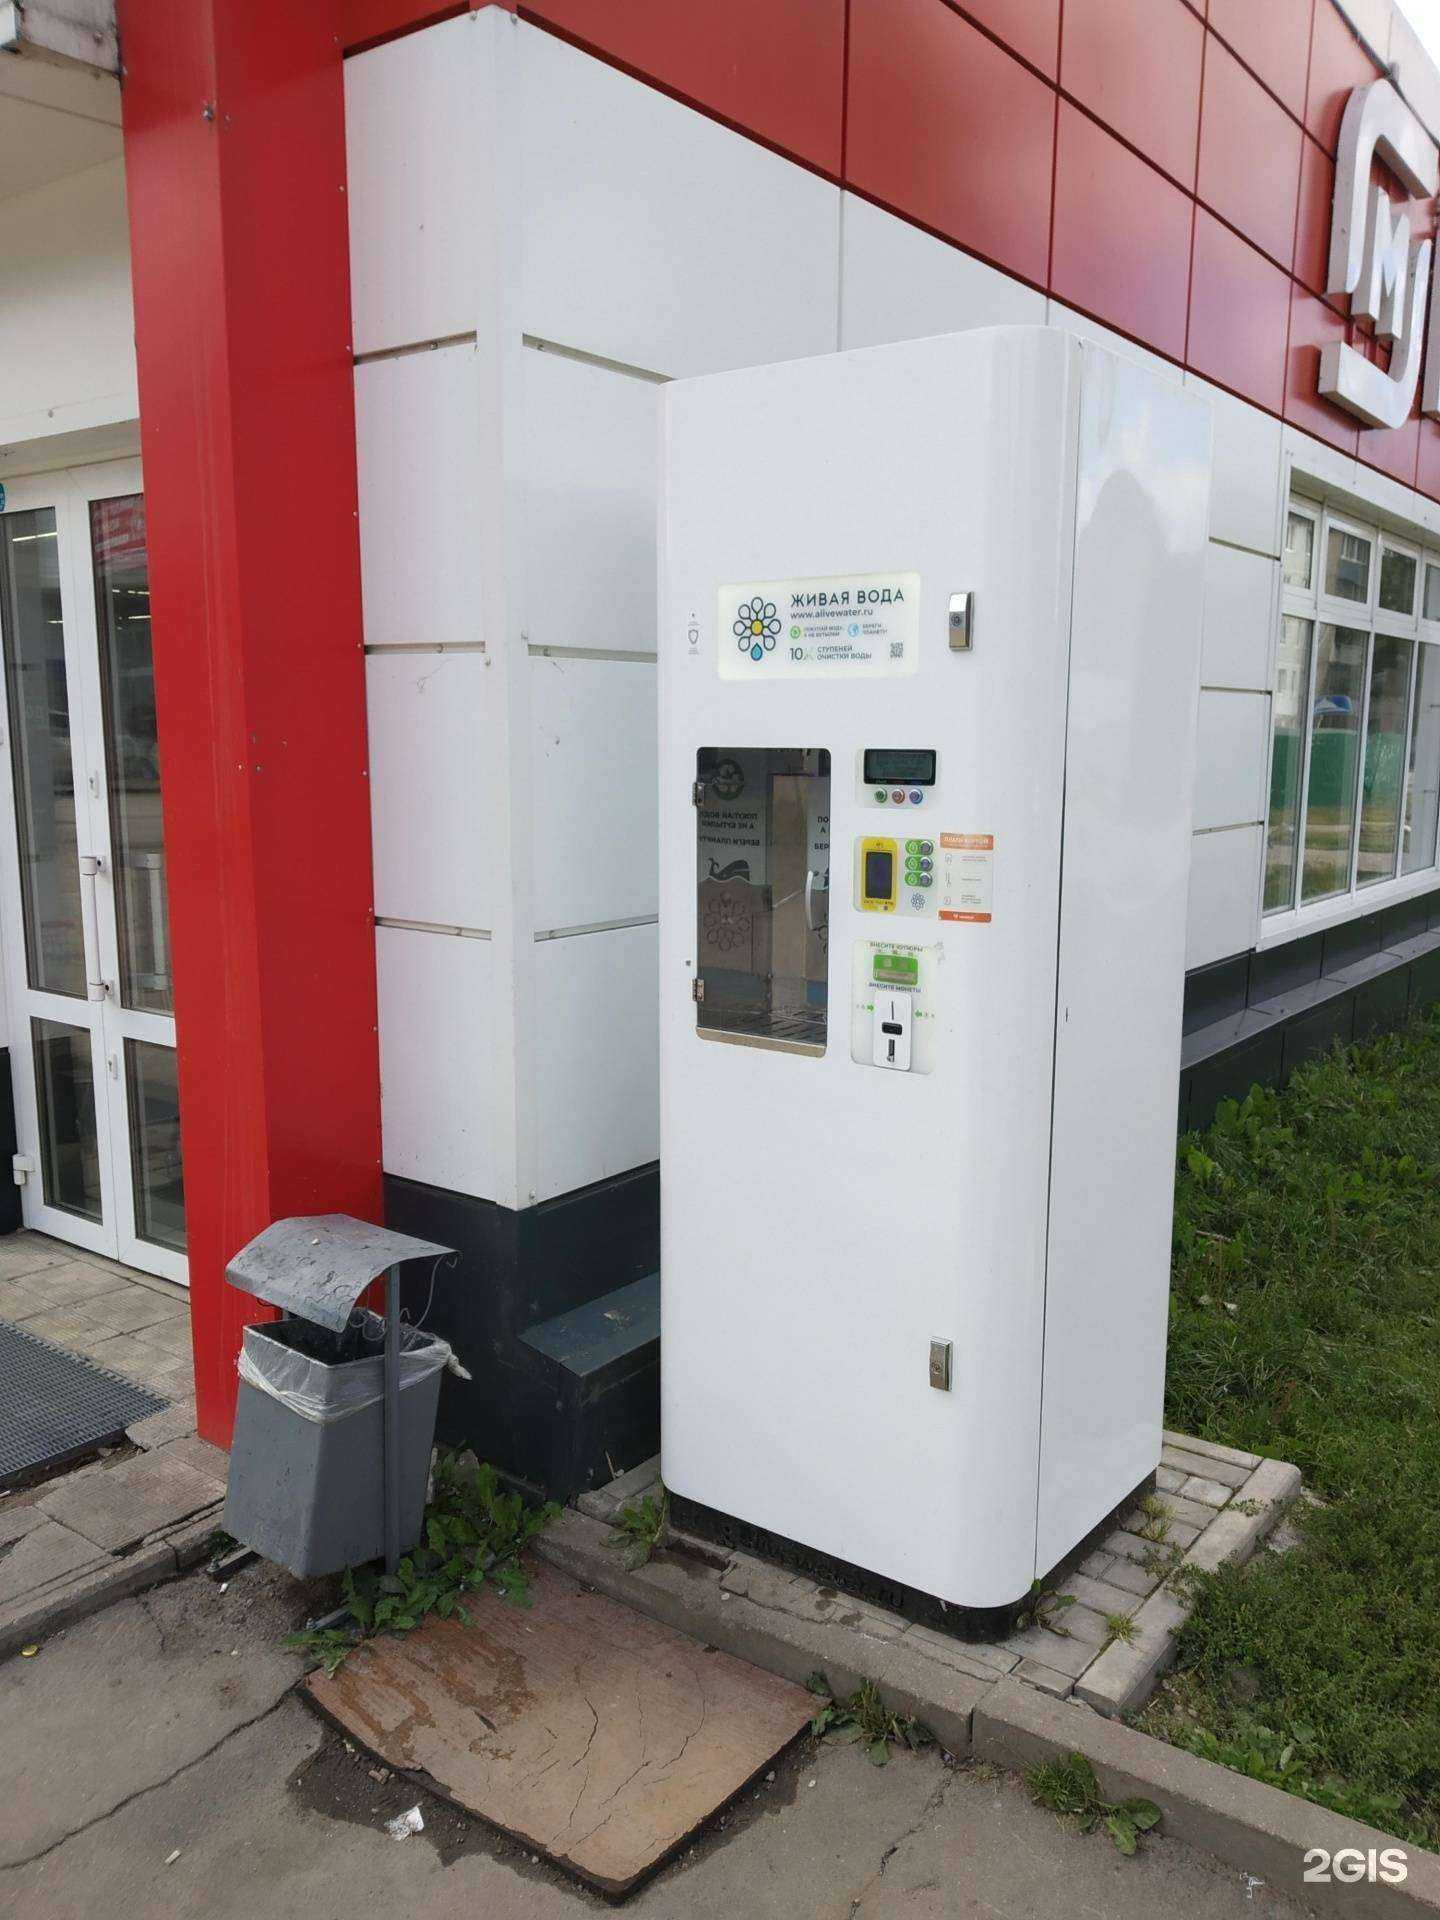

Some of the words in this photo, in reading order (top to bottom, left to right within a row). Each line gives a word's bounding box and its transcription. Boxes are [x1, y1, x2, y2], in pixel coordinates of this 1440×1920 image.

[791, 591, 850, 607] ЖИВАЯ
[857, 588, 905, 605] ВОДА
[790, 608, 873, 619] www.alivewater.ru
[817, 645, 853, 653] СТУПЕНЕЙ
[817, 652, 849, 660] ОЧИСТКИ
[850, 651, 872, 660] ВОДЫ
